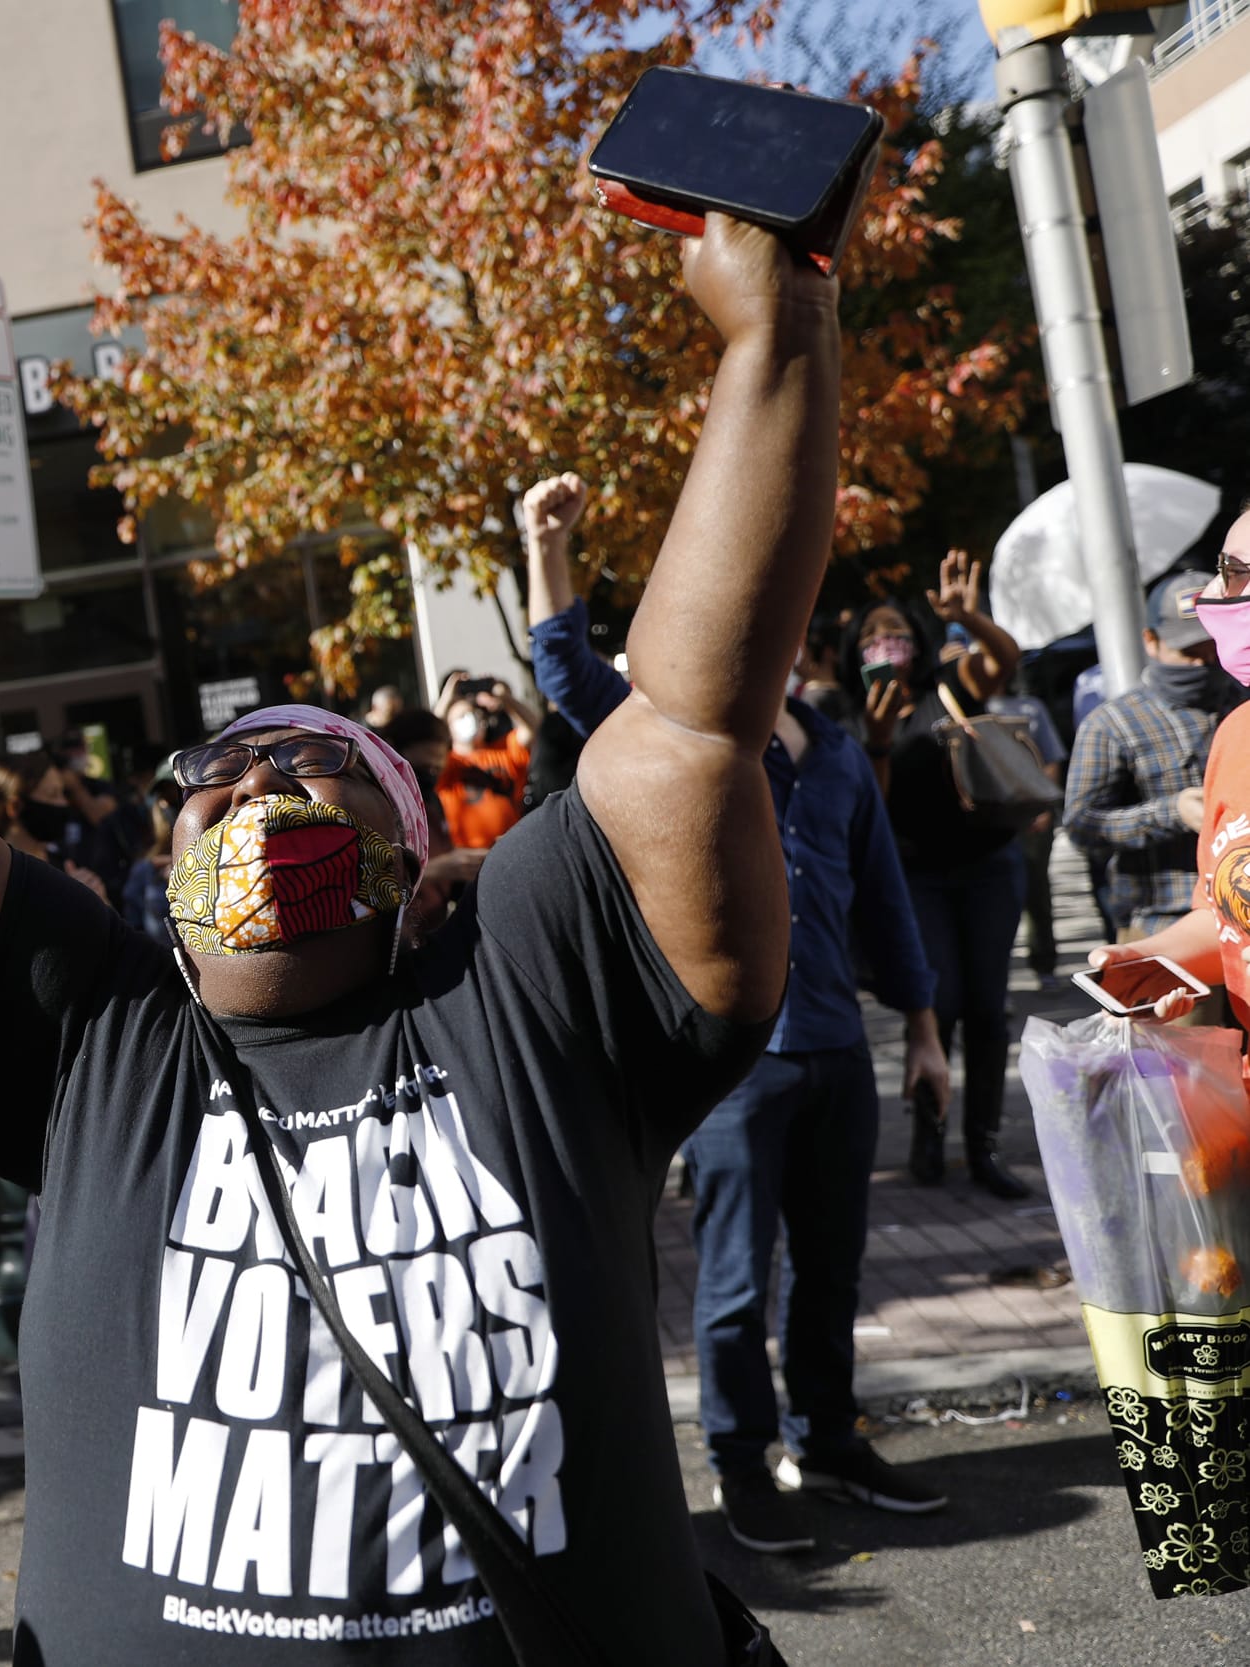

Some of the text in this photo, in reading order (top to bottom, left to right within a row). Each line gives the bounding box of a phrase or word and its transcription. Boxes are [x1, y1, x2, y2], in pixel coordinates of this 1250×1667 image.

[168, 1092, 524, 1268] BLACK
[156, 1231, 558, 1427] VOTERS
[1151, 1333, 1202, 1351] MARKET
[122, 1399, 568, 1599] MATTER
[163, 1595, 494, 1641] BlackVotersMatterFund.o
